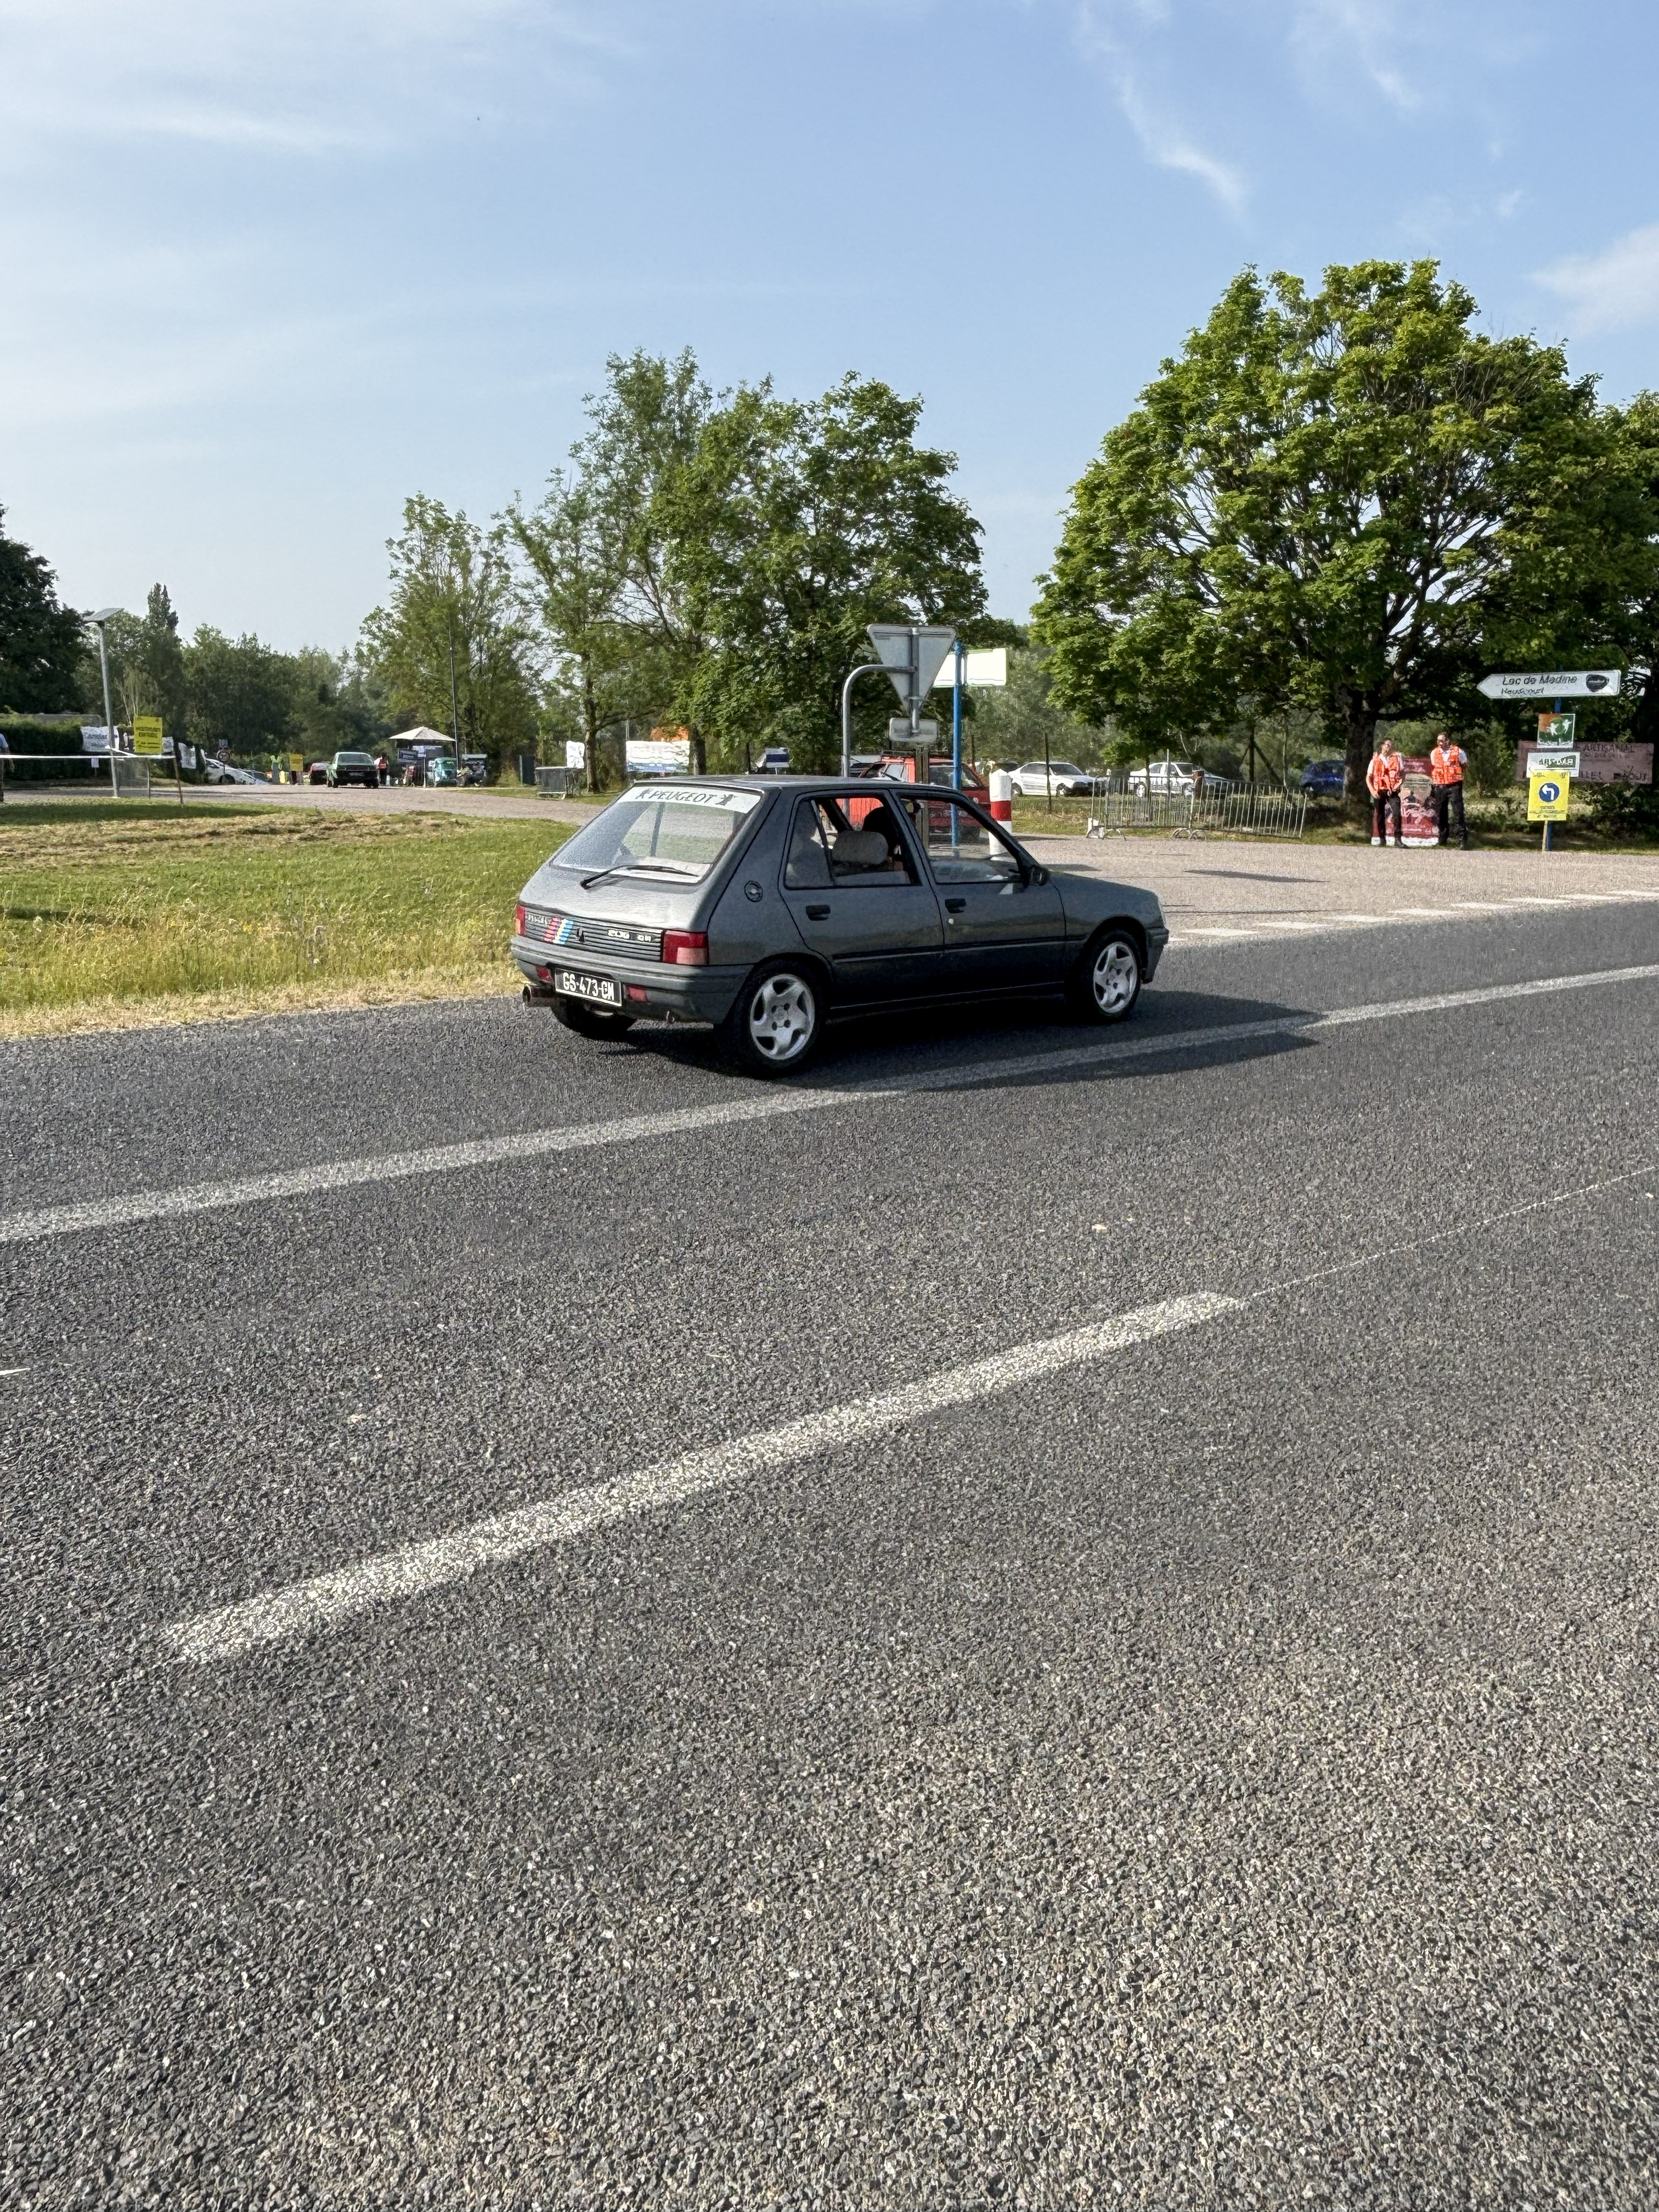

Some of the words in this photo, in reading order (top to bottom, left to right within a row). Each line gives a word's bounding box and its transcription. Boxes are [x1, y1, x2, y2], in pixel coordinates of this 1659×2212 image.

[1503, 674, 1521, 685] Lac
[1523, 675, 1537, 685] de
[1539, 674, 1578, 684] Madine
[648, 790, 717, 803] PEUGEOT
